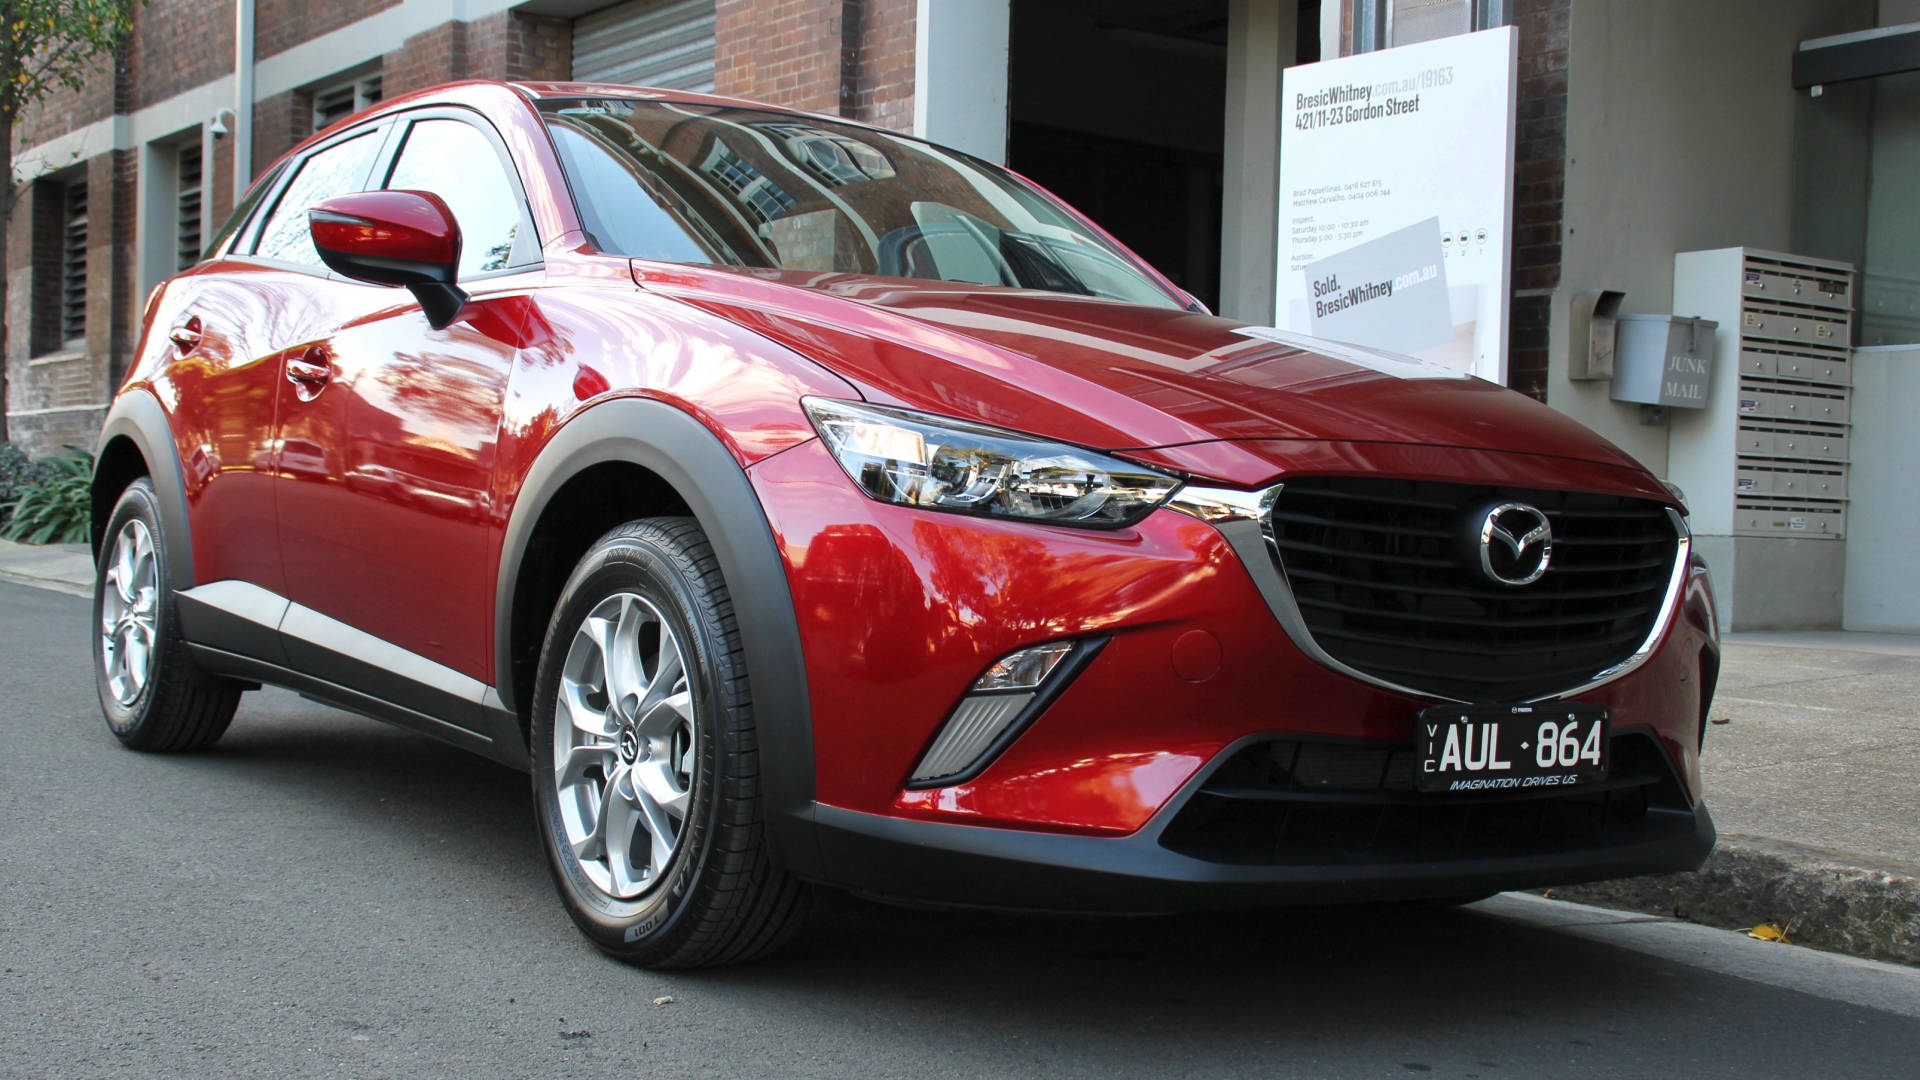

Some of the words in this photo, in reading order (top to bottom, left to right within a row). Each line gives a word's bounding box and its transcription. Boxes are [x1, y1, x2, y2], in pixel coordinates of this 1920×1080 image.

[1296, 66, 1454, 110] BresicWhitney.com.au/19163
[1295, 107, 1344, 130] 421/11-23
[1345, 103, 1384, 123] Gordon
[1386, 94, 1420, 116] Street
[1313, 274, 1341, 298] Sold.
[1315, 264, 1438, 319] BresicWhitney.com.au
[1667, 356, 1706, 374] JUNK
[1665, 381, 1702, 400] MAIL
[1439, 722, 1511, 771] AUL
[1536, 720, 1601, 768] 864
[1450, 777, 1521, 791] IMAGINATION
[1522, 775, 1561, 787] DRIVES
[1562, 774, 1578, 785] US
